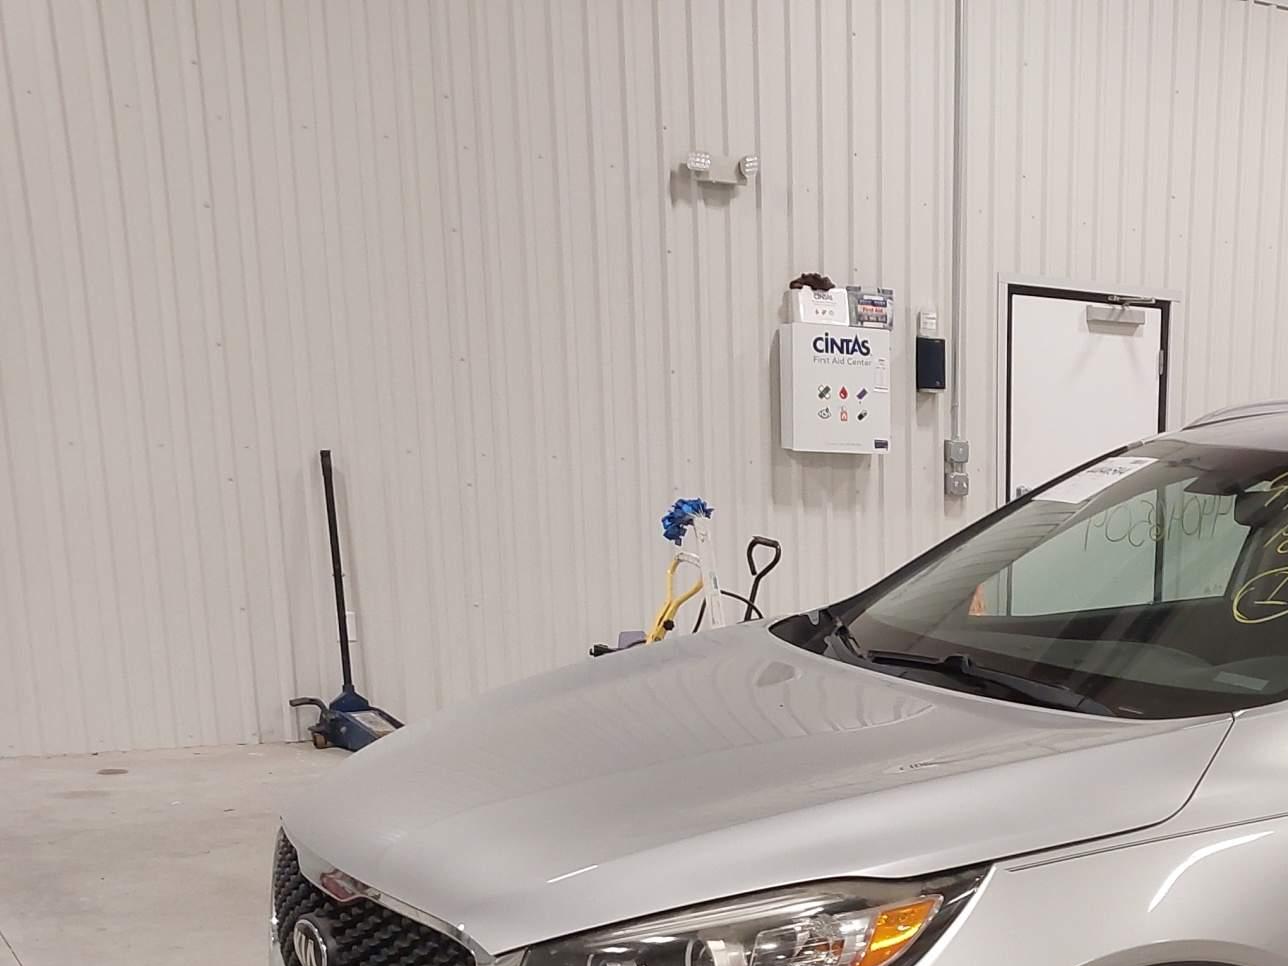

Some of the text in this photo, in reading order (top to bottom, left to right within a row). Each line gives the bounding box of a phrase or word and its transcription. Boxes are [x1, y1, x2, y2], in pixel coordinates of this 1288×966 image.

[813, 332, 871, 356] CINTAS
[813, 356, 830, 364] First
[832, 357, 845, 365] Aid
[847, 358, 871, 366] Center
